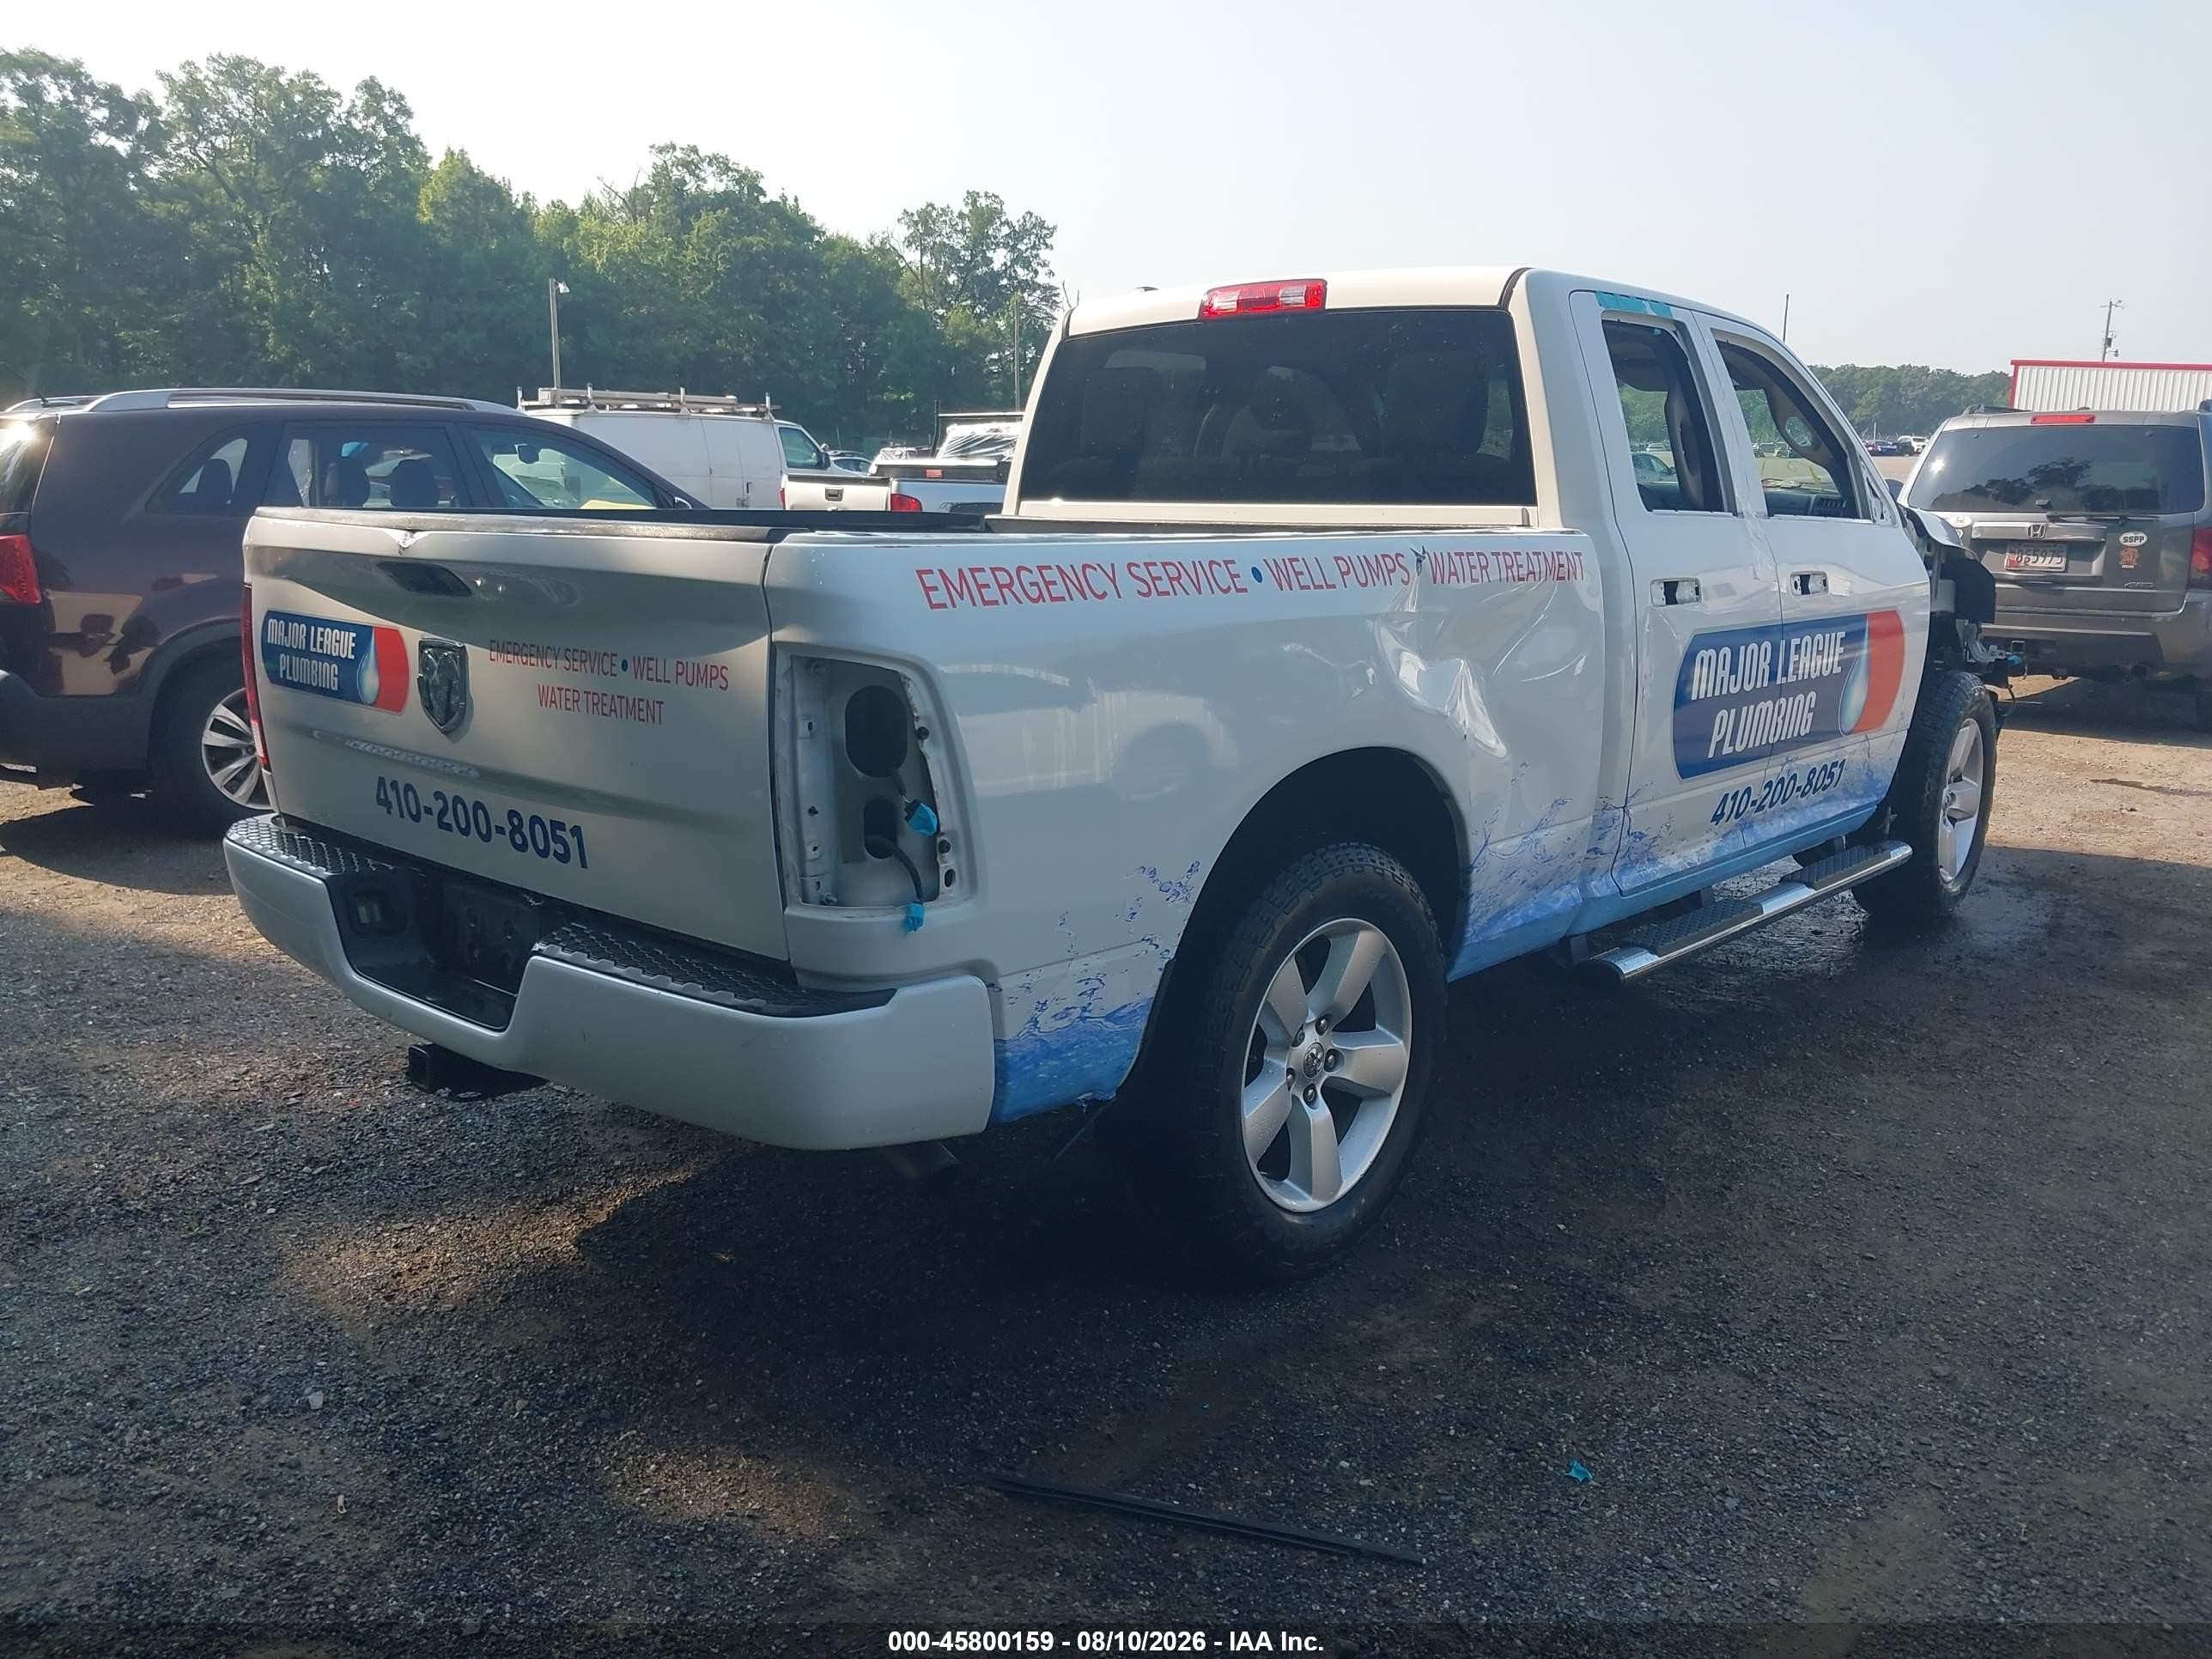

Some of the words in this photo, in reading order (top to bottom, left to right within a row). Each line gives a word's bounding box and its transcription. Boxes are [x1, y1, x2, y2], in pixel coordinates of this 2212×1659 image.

[915, 562, 1122, 610] EMERGENCY
[1127, 559, 1249, 599] SERVICE
[1263, 556, 1337, 592] WELL
[1333, 552, 1411, 588] PUMPS
[1426, 551, 1492, 585] WATER
[1491, 550, 1583, 583] TREATMENT
[267, 618, 307, 650] MAJOR
[310, 625, 356, 659] LEAGUE
[489, 639, 561, 670] EMERGENCY
[563, 647, 617, 678] SERVICE
[632, 655, 672, 684] WELL
[675, 660, 729, 691] PUMPS
[1691, 641, 1772, 701] MAJOR
[1776, 631, 1845, 685] LEAGUE
[279, 653, 338, 691] PLUMBING
[537, 684, 580, 713] WATER
[583, 690, 665, 725] TREATMENT
[1707, 690, 1816, 759] PLUMBING
[375, 775, 588, 869] 410-200-8051
[1710, 758, 1846, 826] 410-200-8051
